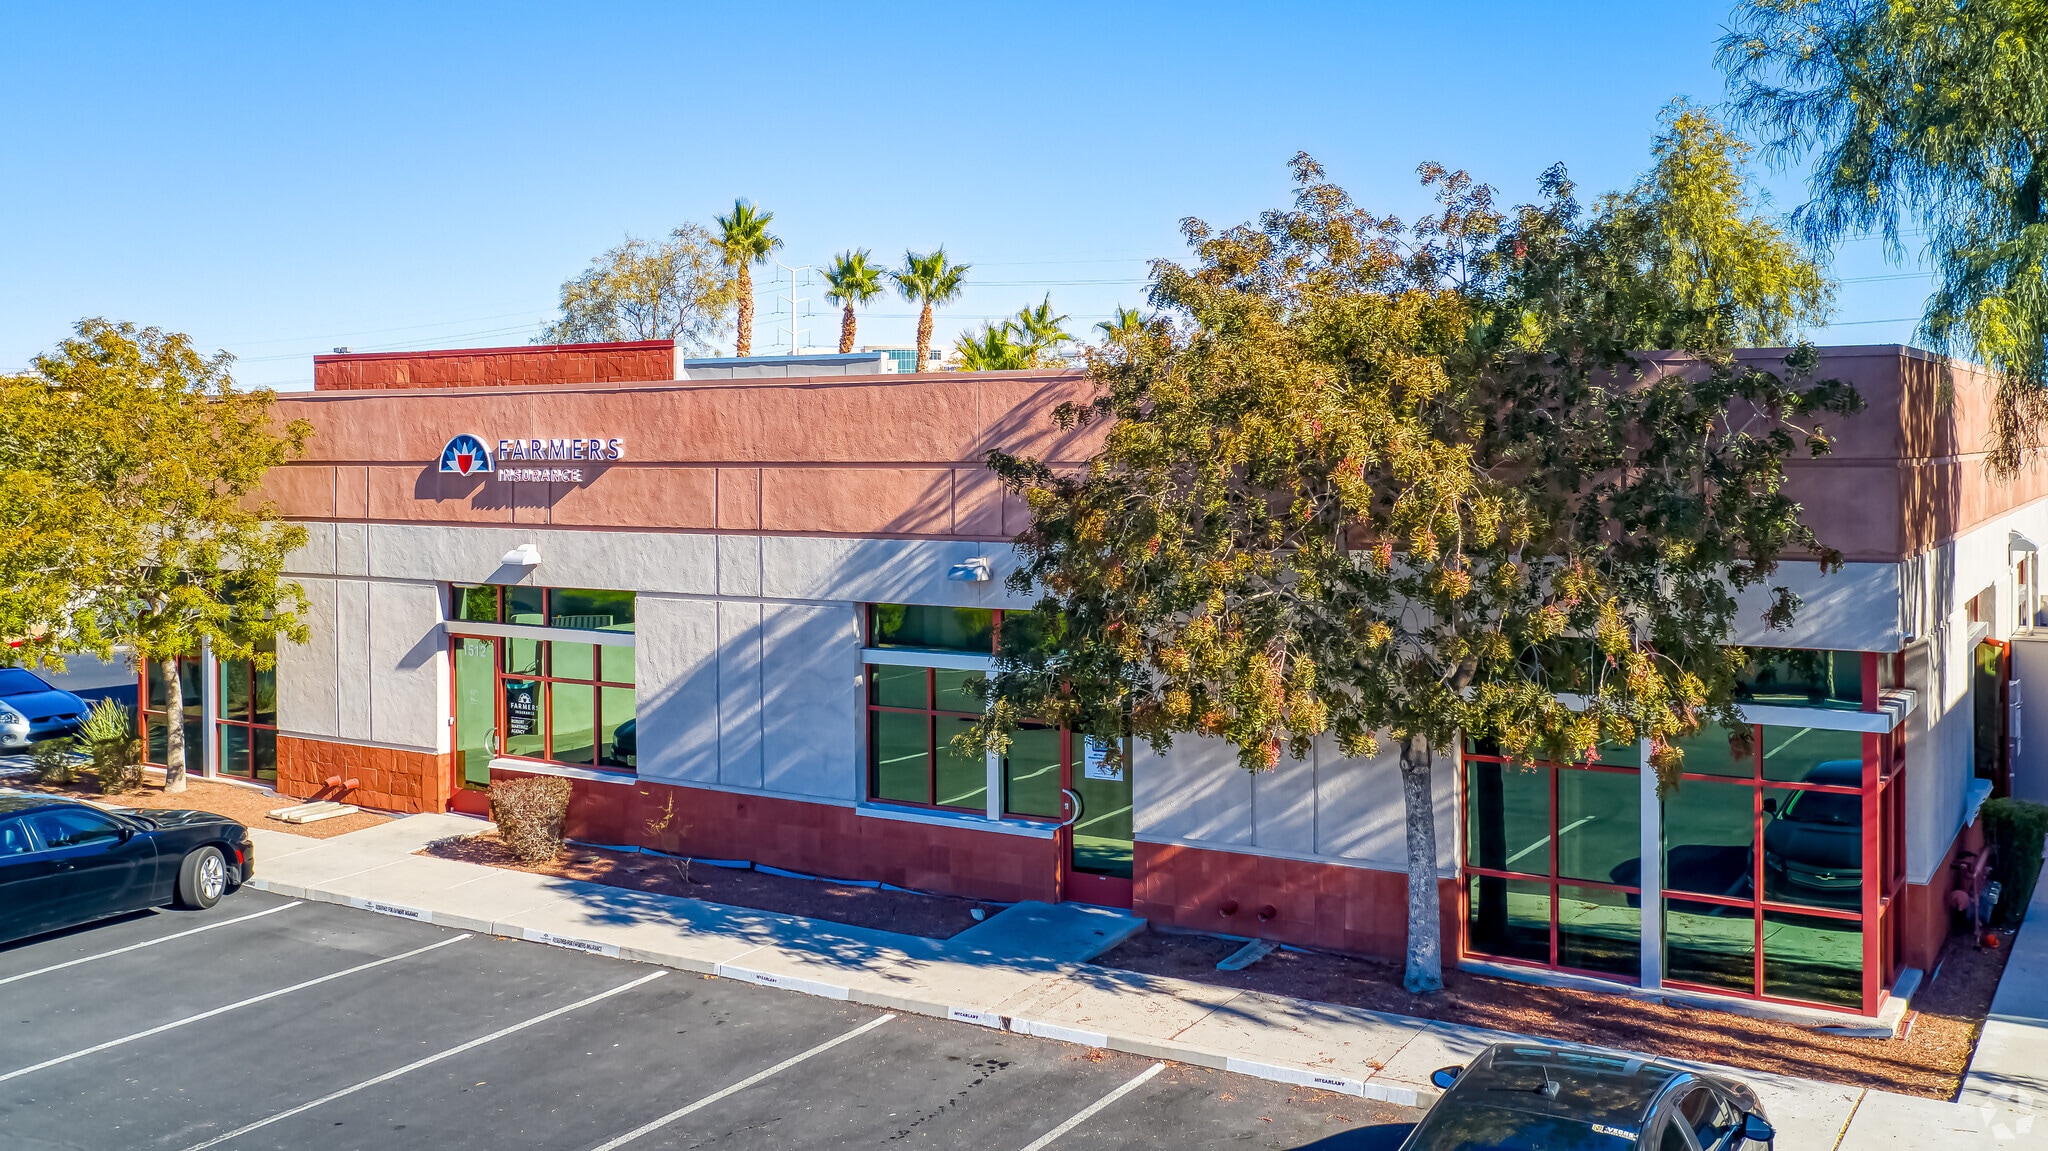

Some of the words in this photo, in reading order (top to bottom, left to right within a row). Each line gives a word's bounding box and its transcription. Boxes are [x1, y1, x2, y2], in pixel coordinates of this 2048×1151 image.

[498, 438, 624, 461] FARMERS
[498, 469, 583, 482] INSURANCE
[463, 644, 487, 658] 1512
[510, 702, 539, 711] FARMERS
